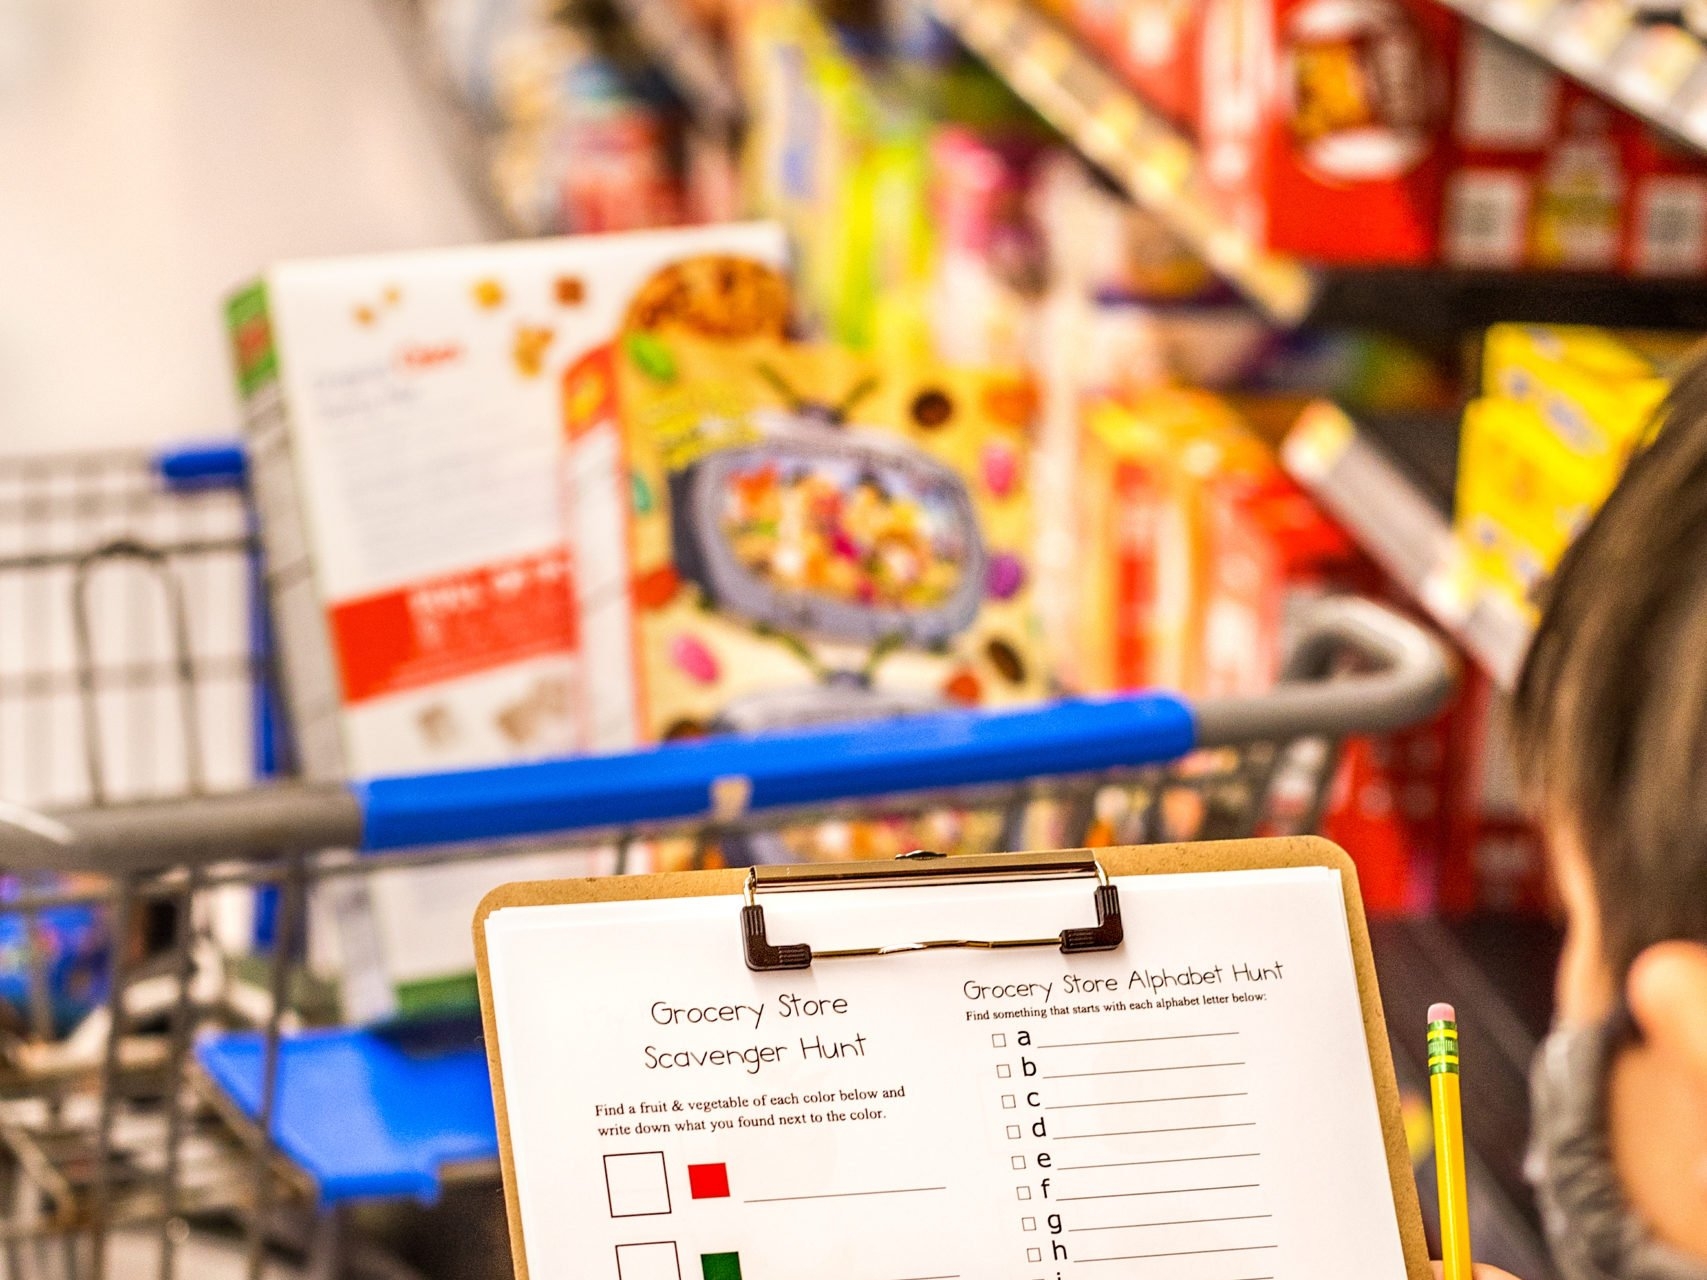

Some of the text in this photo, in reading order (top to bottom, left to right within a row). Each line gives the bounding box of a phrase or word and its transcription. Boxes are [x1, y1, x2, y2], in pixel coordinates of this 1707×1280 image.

[963, 960, 1284, 1004] Grocery Store Alphabet Hunt
[650, 993, 849, 1030] Grocery Store
[965, 991, 1268, 1022] Find something that starts with each alphabet letter below:
[1017, 1030, 1032, 1047] a
[644, 1032, 867, 1075] Scavenger Hunt
[1021, 1056, 1037, 1077] b
[595, 1085, 906, 1117] Find a fruit & vegetable of each color below and
[1026, 1091, 1041, 1108] c
[597, 1107, 888, 1137] write down what you found next to the color.
[1031, 1116, 1047, 1138] d
[1036, 1152, 1052, 1168] e
[1040, 1177, 1052, 1200] f
[1047, 1213, 1063, 1235] g
[1051, 1239, 1068, 1261] h
